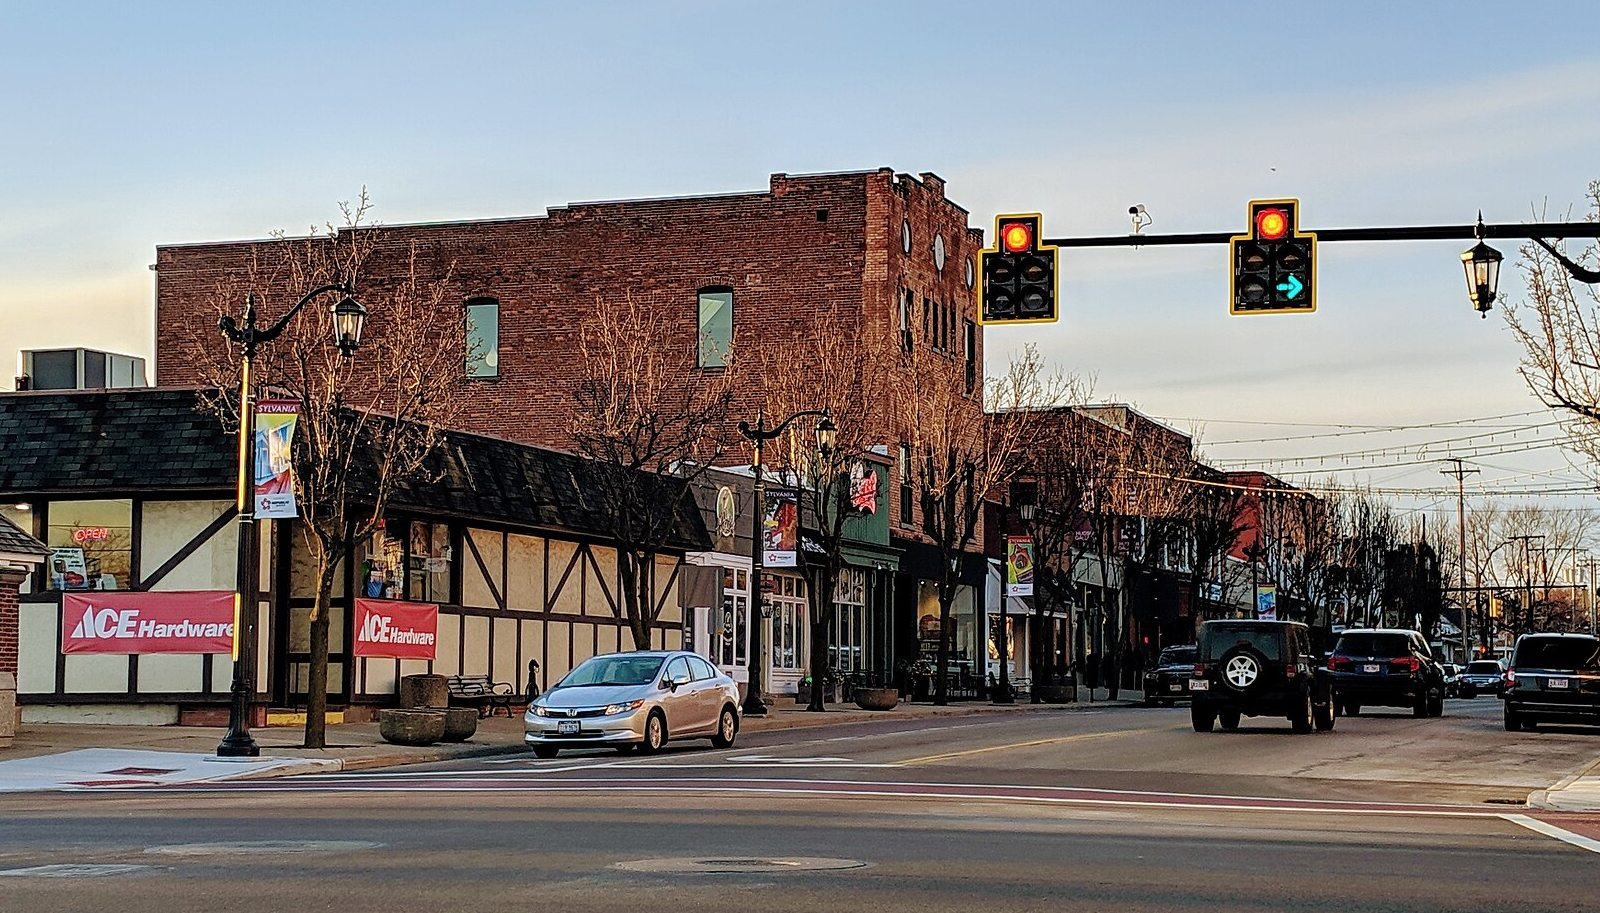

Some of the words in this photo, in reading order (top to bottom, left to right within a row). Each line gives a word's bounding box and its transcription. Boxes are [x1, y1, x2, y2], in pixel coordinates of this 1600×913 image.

[258, 405, 297, 413] SYLVANIA
[75, 529, 107, 541] OPEN
[70, 604, 139, 639] ACE
[138, 619, 234, 638] Hardware
[358, 610, 392, 642] ACE
[389, 627, 435, 646] Hardware
